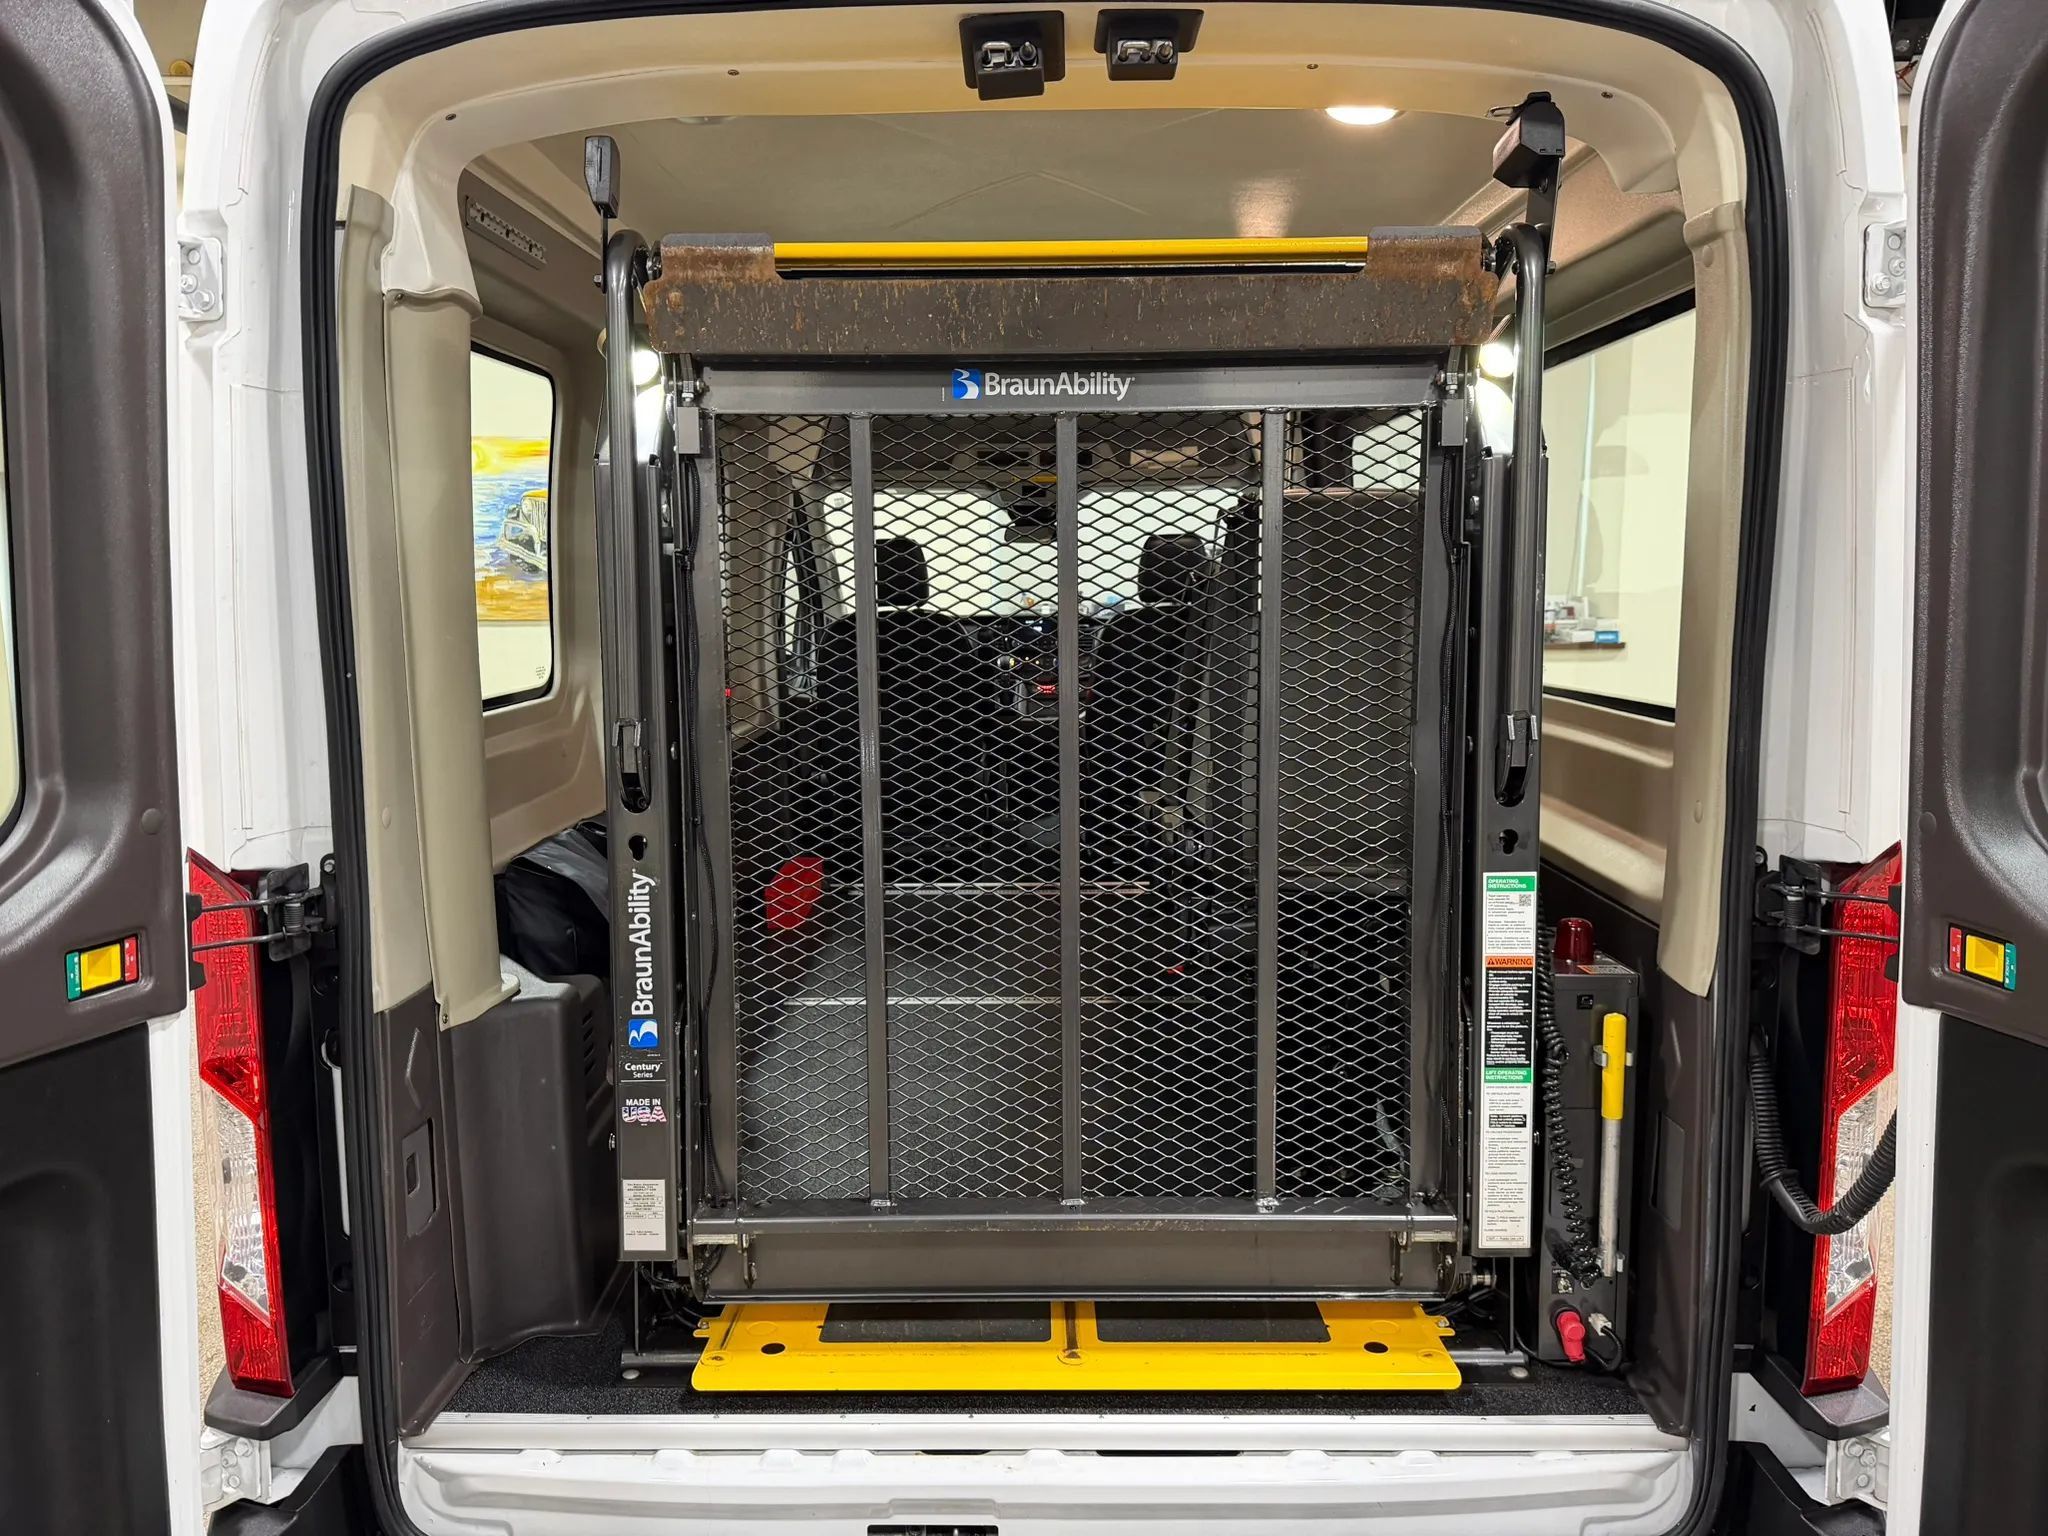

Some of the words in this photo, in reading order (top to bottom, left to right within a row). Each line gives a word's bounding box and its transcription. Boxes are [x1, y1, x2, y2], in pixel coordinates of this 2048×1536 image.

[984, 371, 1132, 402] BraunAbility
[628, 871, 657, 1015] BraunAbility
[624, 1062, 661, 1073] Century
[626, 1098, 650, 1106] MADE
[622, 1105, 667, 1123] USA
